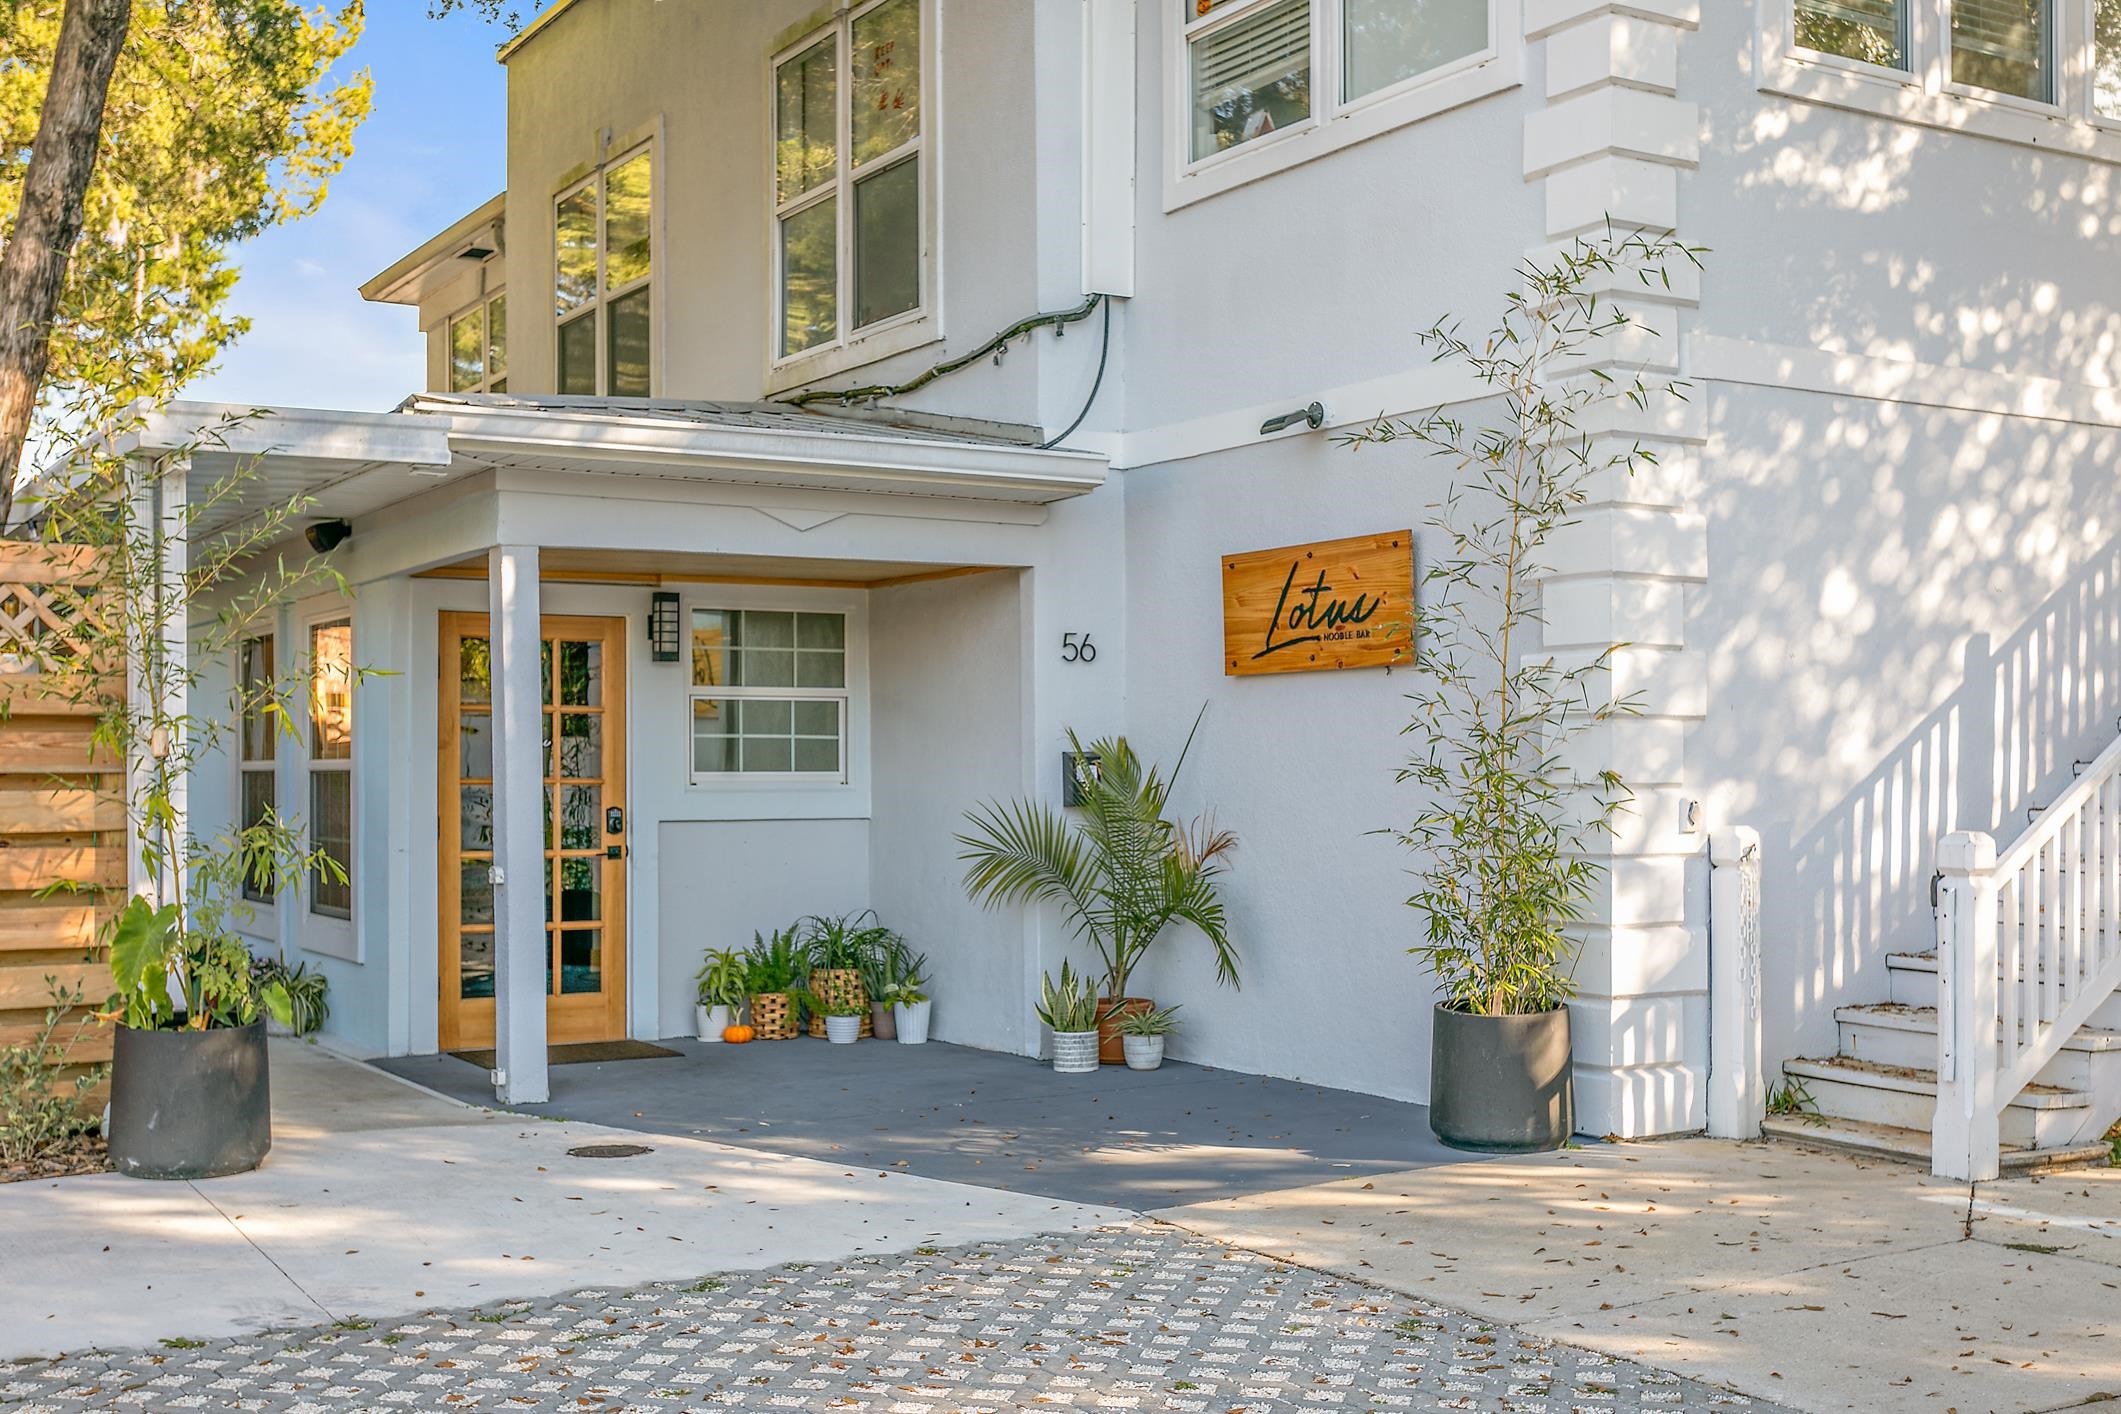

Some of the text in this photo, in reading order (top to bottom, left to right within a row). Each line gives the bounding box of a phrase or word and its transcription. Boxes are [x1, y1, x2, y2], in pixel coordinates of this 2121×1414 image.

[1251, 561, 1380, 660] Lotus
[1062, 632, 1096, 662] 56
[1323, 629, 1371, 642] NOODLE BAR
